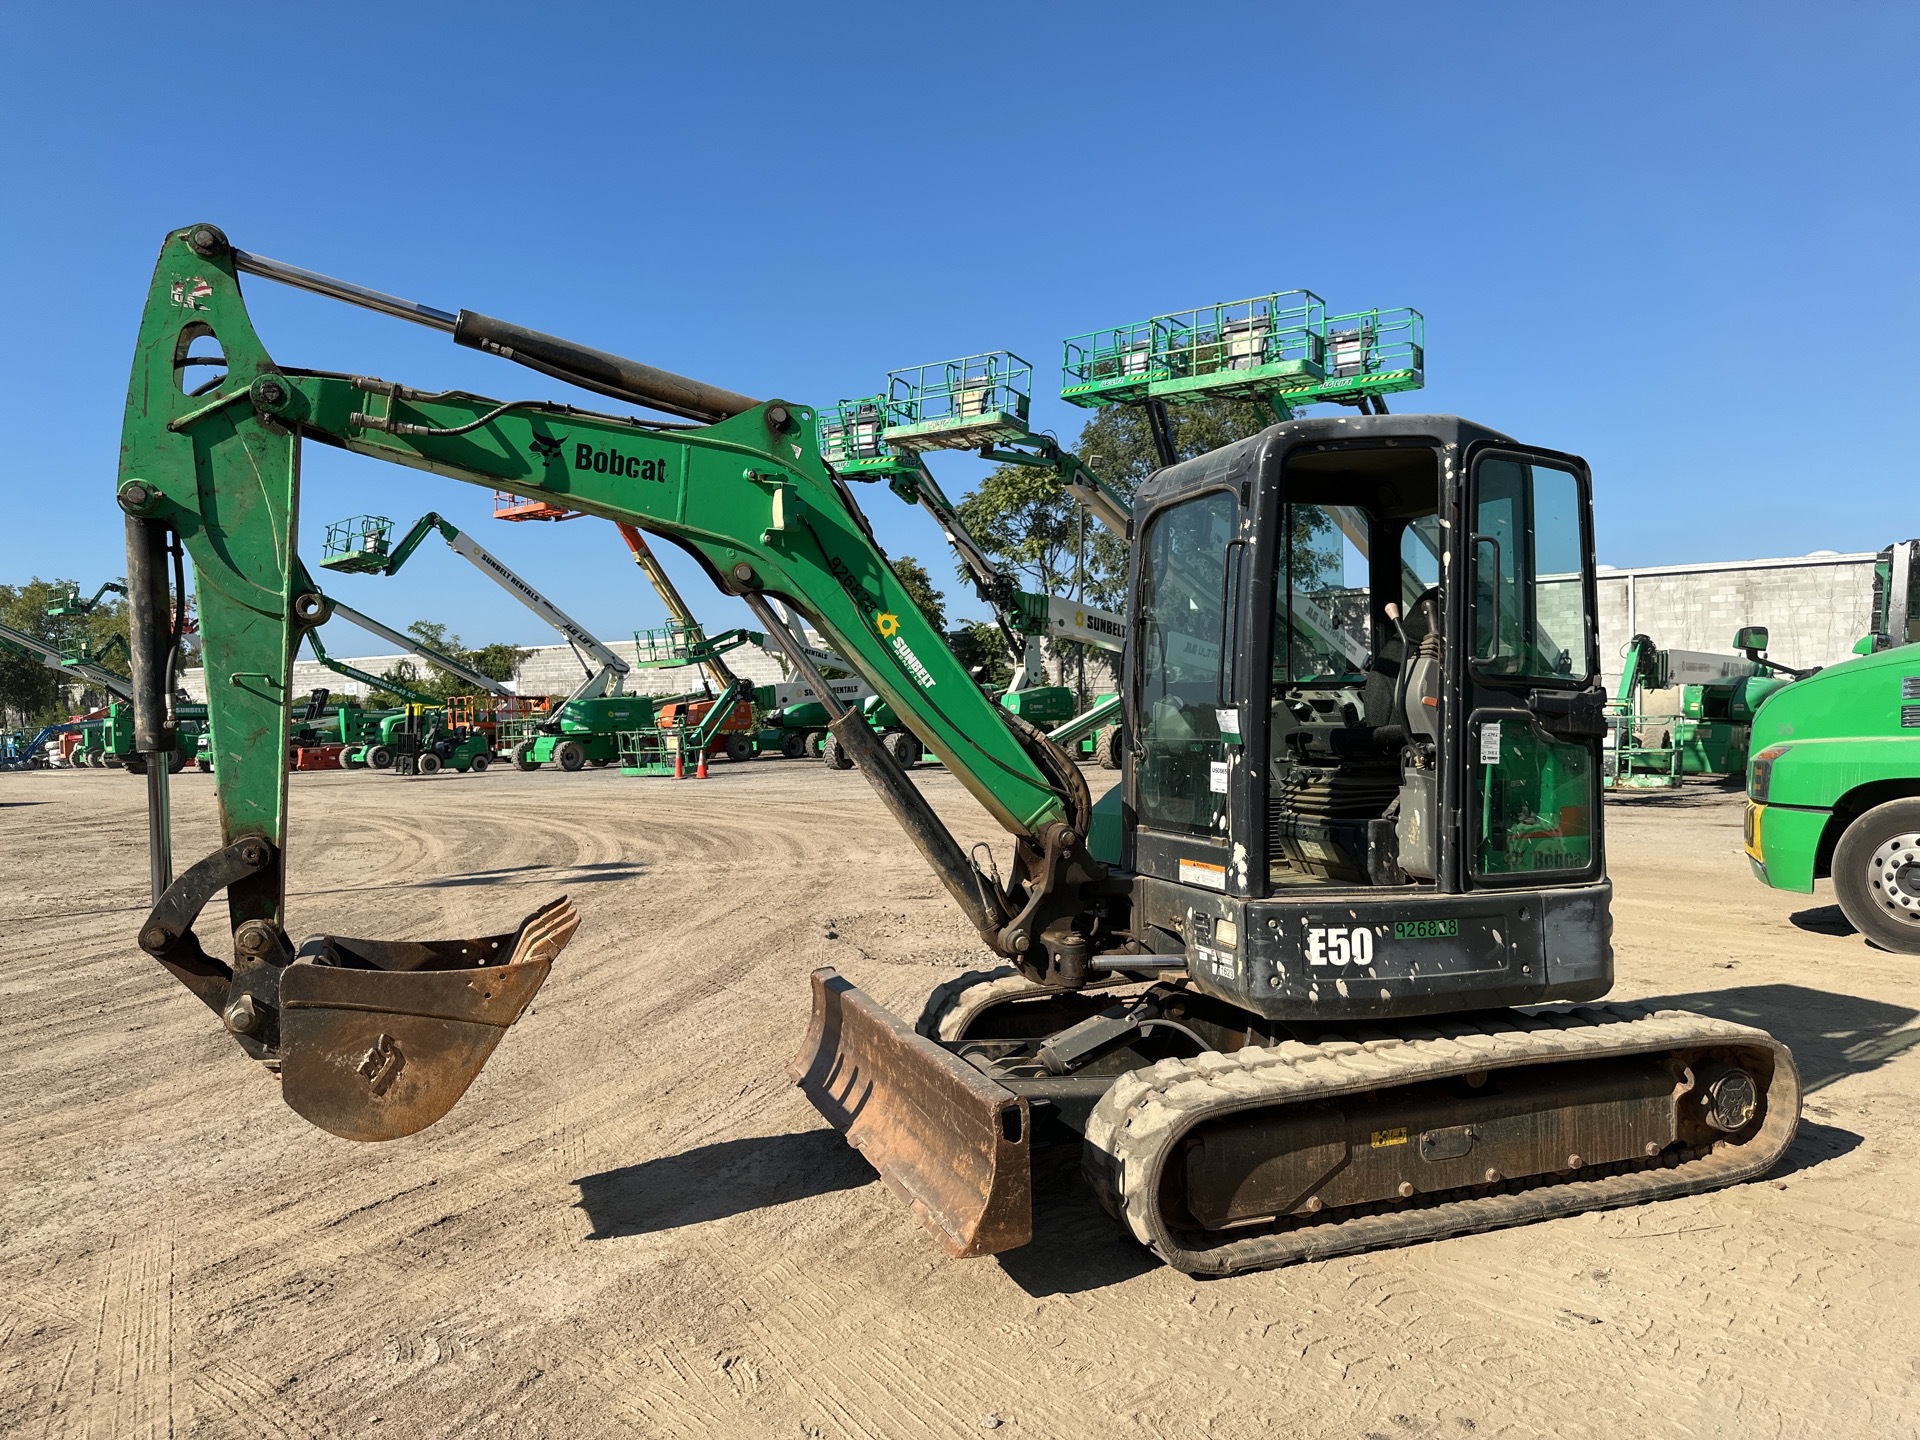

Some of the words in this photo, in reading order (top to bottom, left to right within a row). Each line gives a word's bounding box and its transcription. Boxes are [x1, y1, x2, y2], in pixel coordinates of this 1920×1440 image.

[1319, 381, 1334, 389] JLG
[1335, 379, 1352, 387] LIFT
[575, 442, 667, 483] Bobcat
[481, 553, 512, 580] SUNBELT
[510, 576, 540, 603] RENTALS
[830, 556, 877, 615] 926828
[562, 623, 580, 637] JLG
[577, 634, 596, 649] LIFT
[1086, 614, 1127, 639] SUNBELT
[804, 648, 829, 660] RENTALS
[892, 636, 937, 689] SUNBELT
[893, 649, 924, 687] RENTALS
[407, 691, 417, 699] XC
[832, 685, 859, 695] RENTALS
[1777, 722, 1795, 736] 16
[1395, 918, 1458, 939] 926828
[1308, 926, 1374, 967] E50
